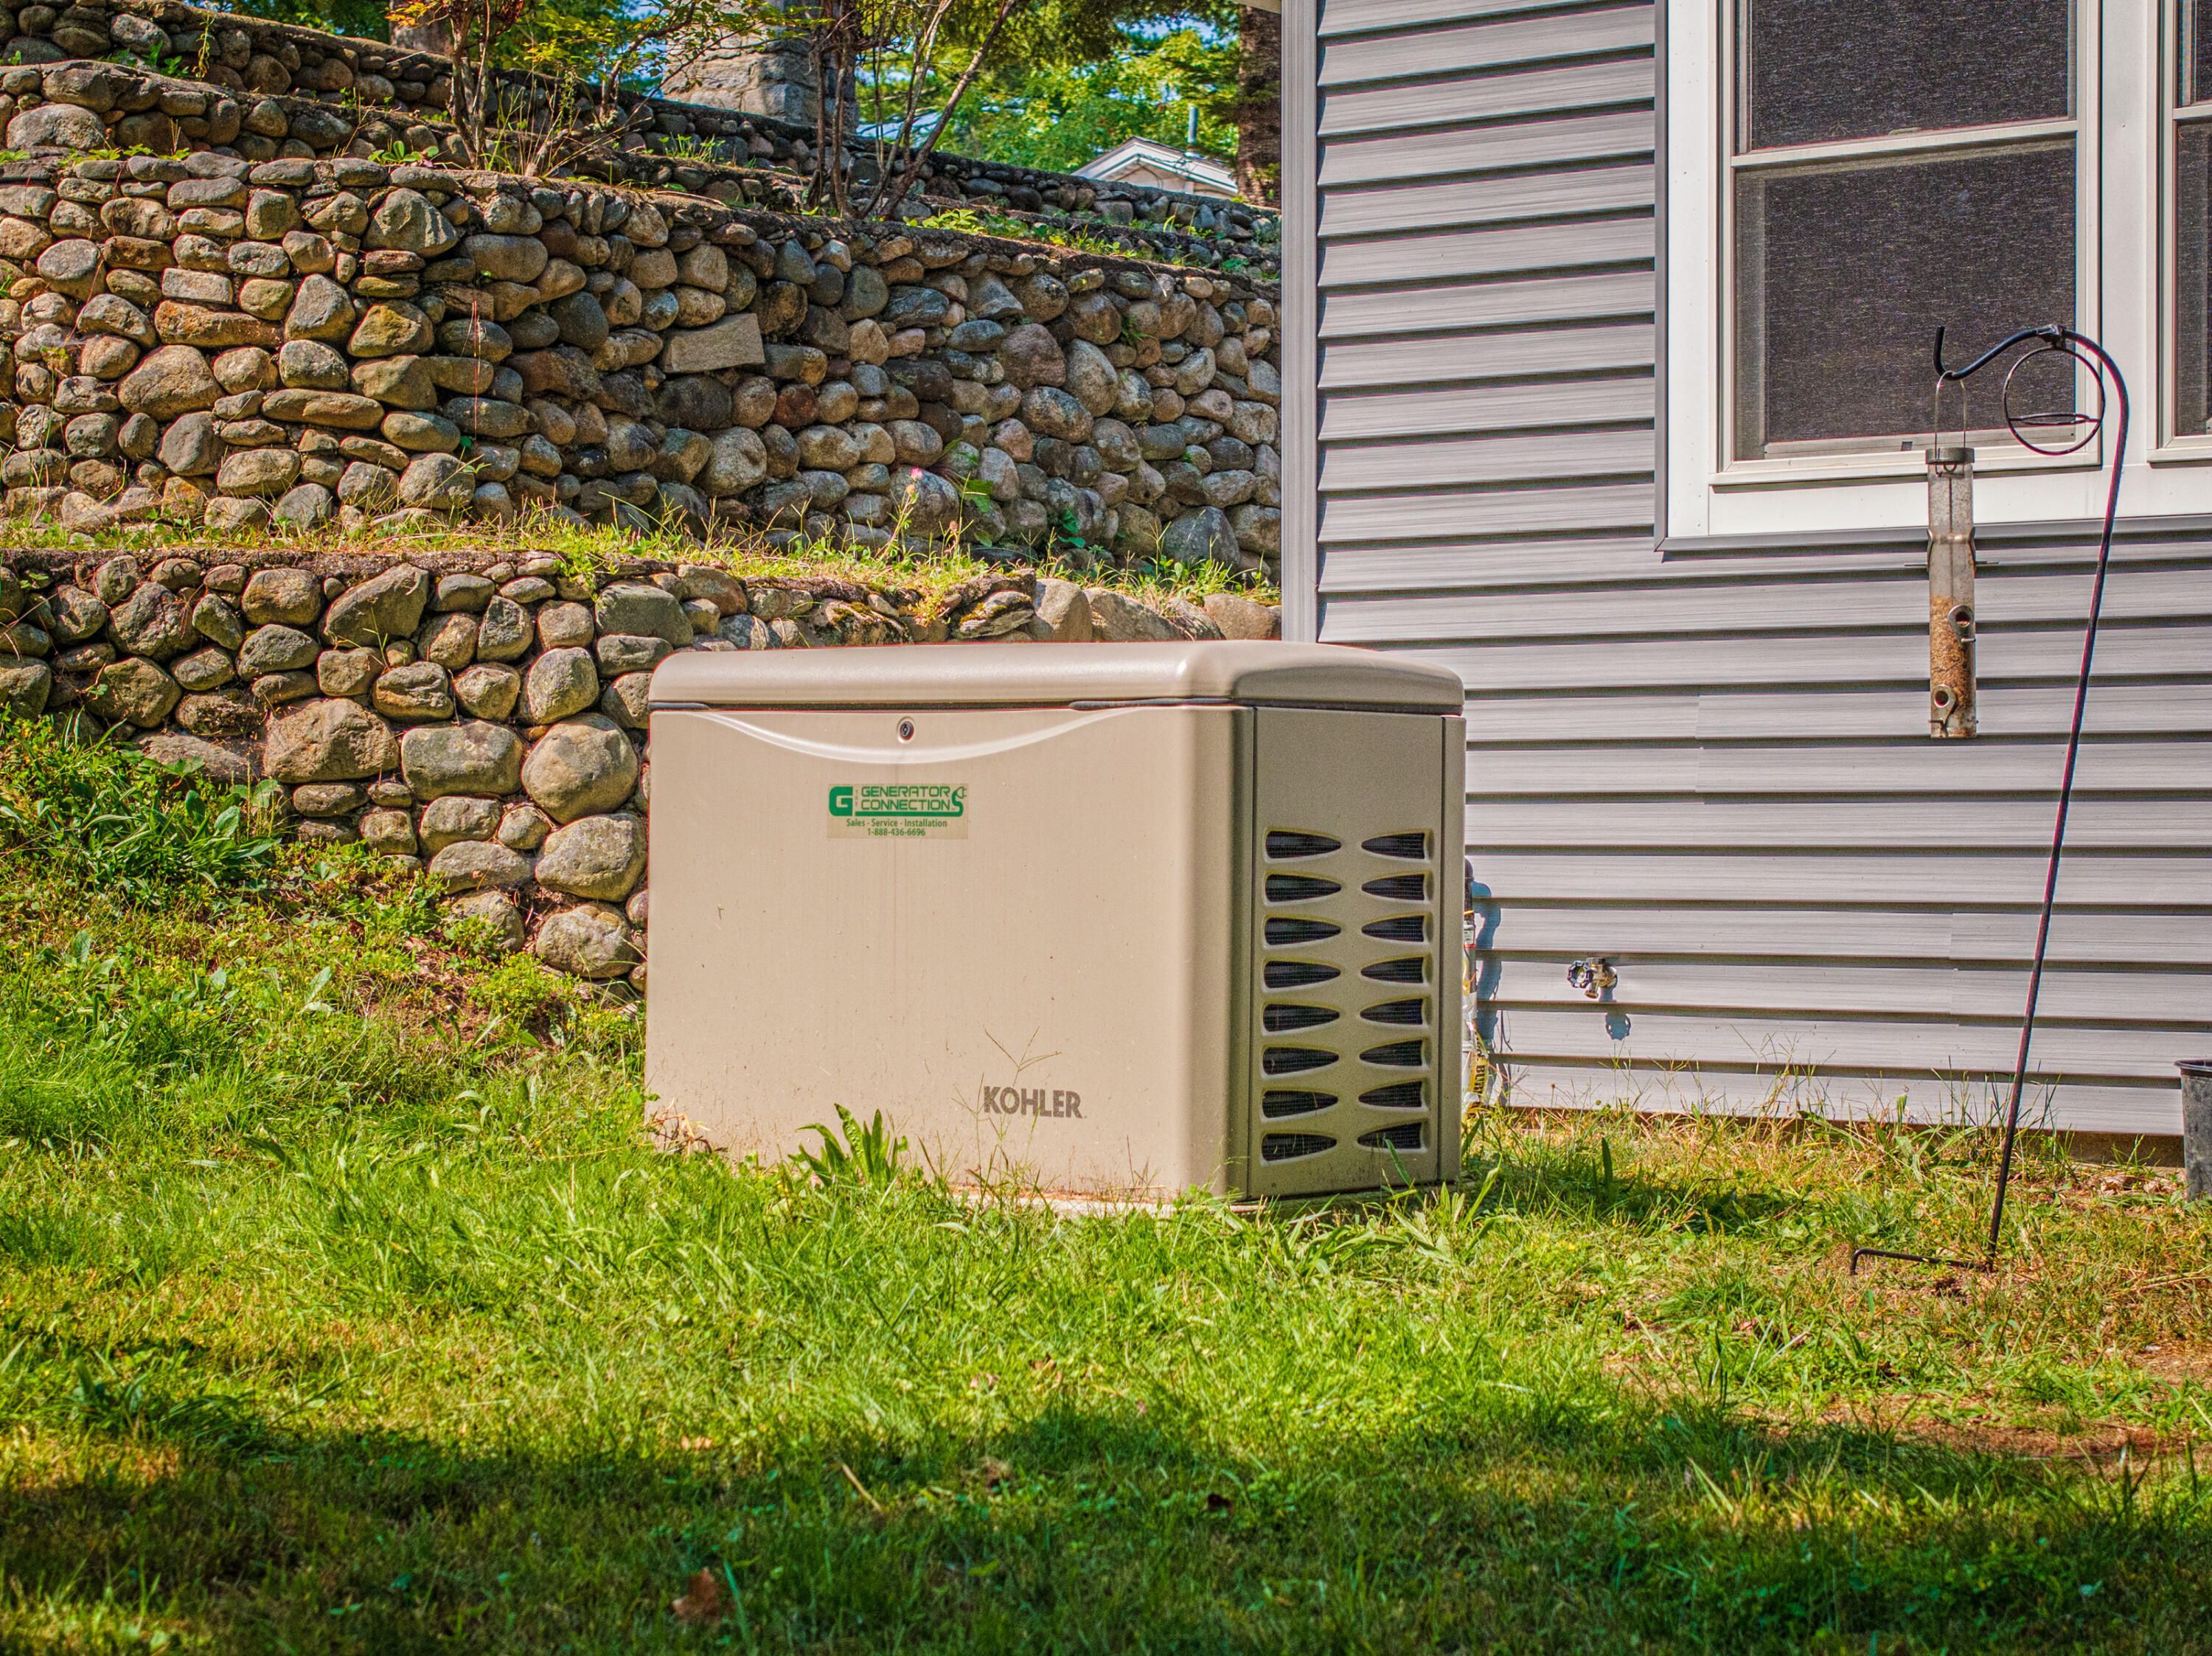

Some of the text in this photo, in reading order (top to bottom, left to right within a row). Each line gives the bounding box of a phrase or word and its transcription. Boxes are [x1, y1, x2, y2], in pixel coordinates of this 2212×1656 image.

[861, 786, 950, 797] GENERATOR
[846, 818, 865, 827] Sales
[871, 818, 898, 827] Service
[904, 818, 947, 827] Installation
[867, 828, 926, 836] 1-888-436-6696
[984, 1086, 1082, 1119] KOHLER
